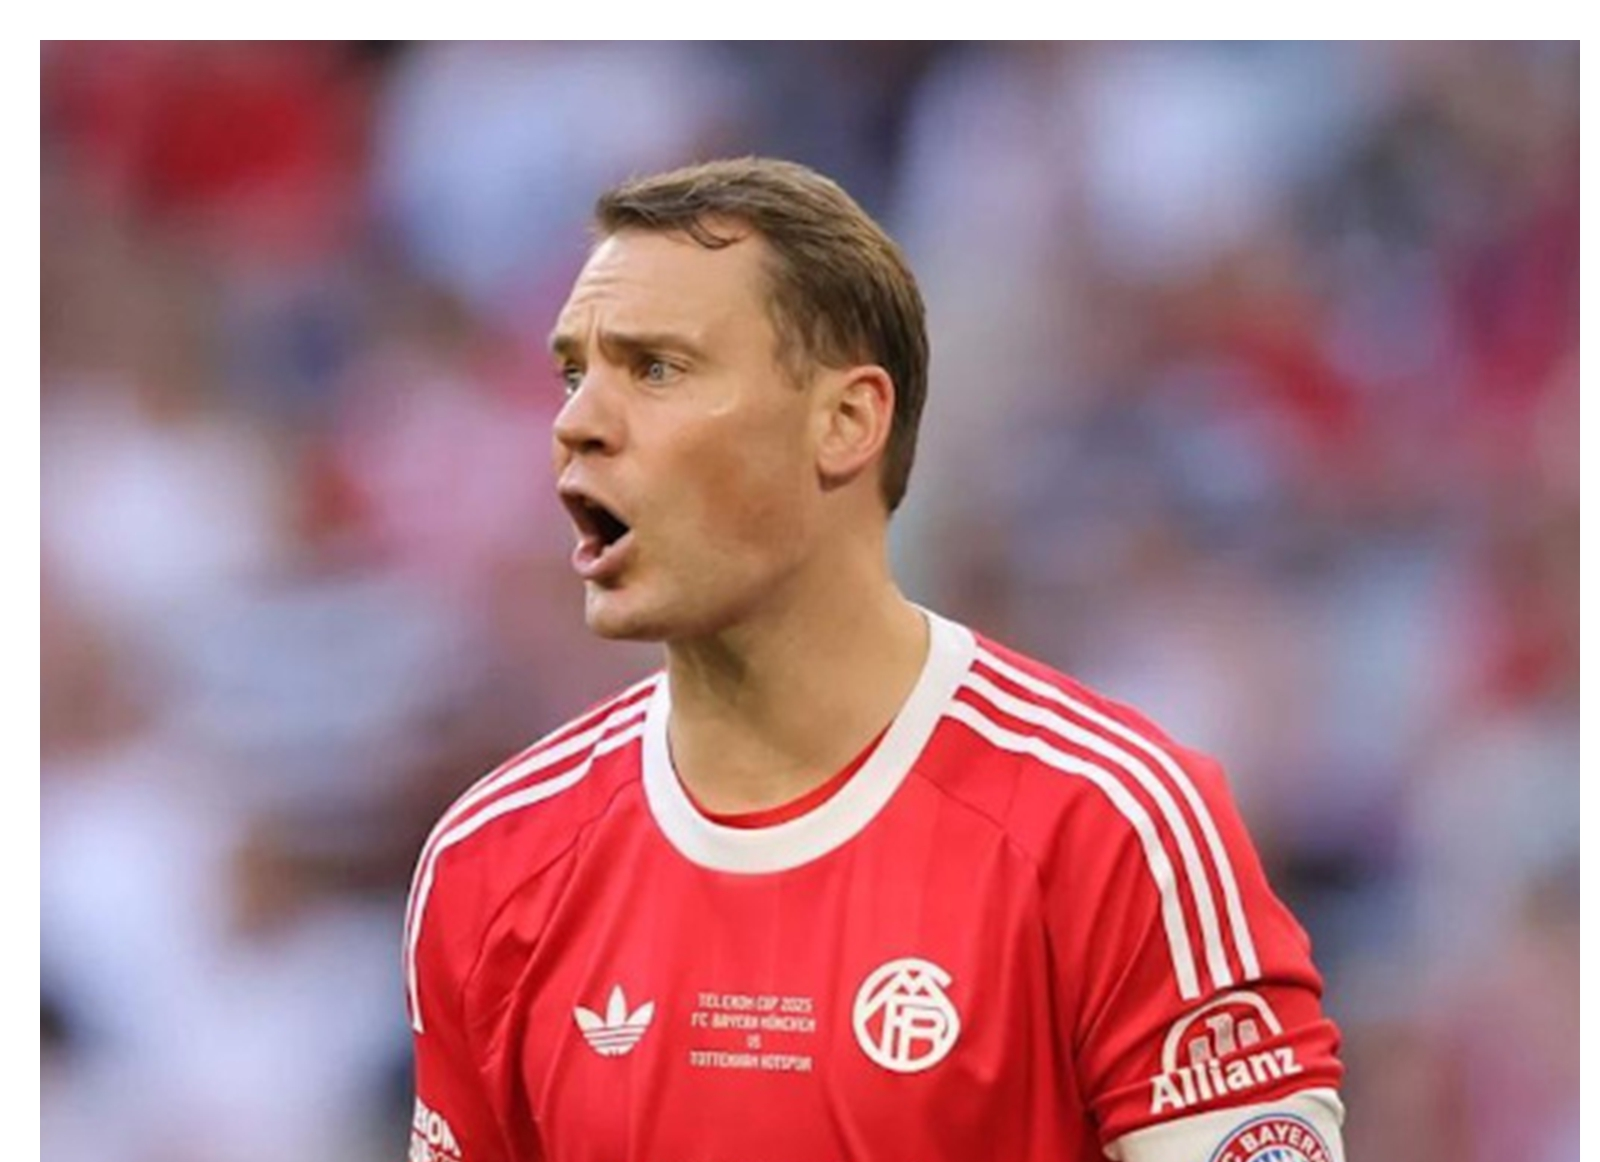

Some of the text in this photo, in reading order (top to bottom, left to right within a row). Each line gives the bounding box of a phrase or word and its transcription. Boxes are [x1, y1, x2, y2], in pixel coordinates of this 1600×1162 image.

[757, 995, 779, 1011] CUP
[781, 997, 812, 1012] 2025
[691, 1011, 709, 1028] FC
[711, 1013, 759, 1030] BAYERN
[689, 1051, 813, 1073] TOTTENHAM HOTSPUR
[1150, 1047, 1304, 1114] Allianz
